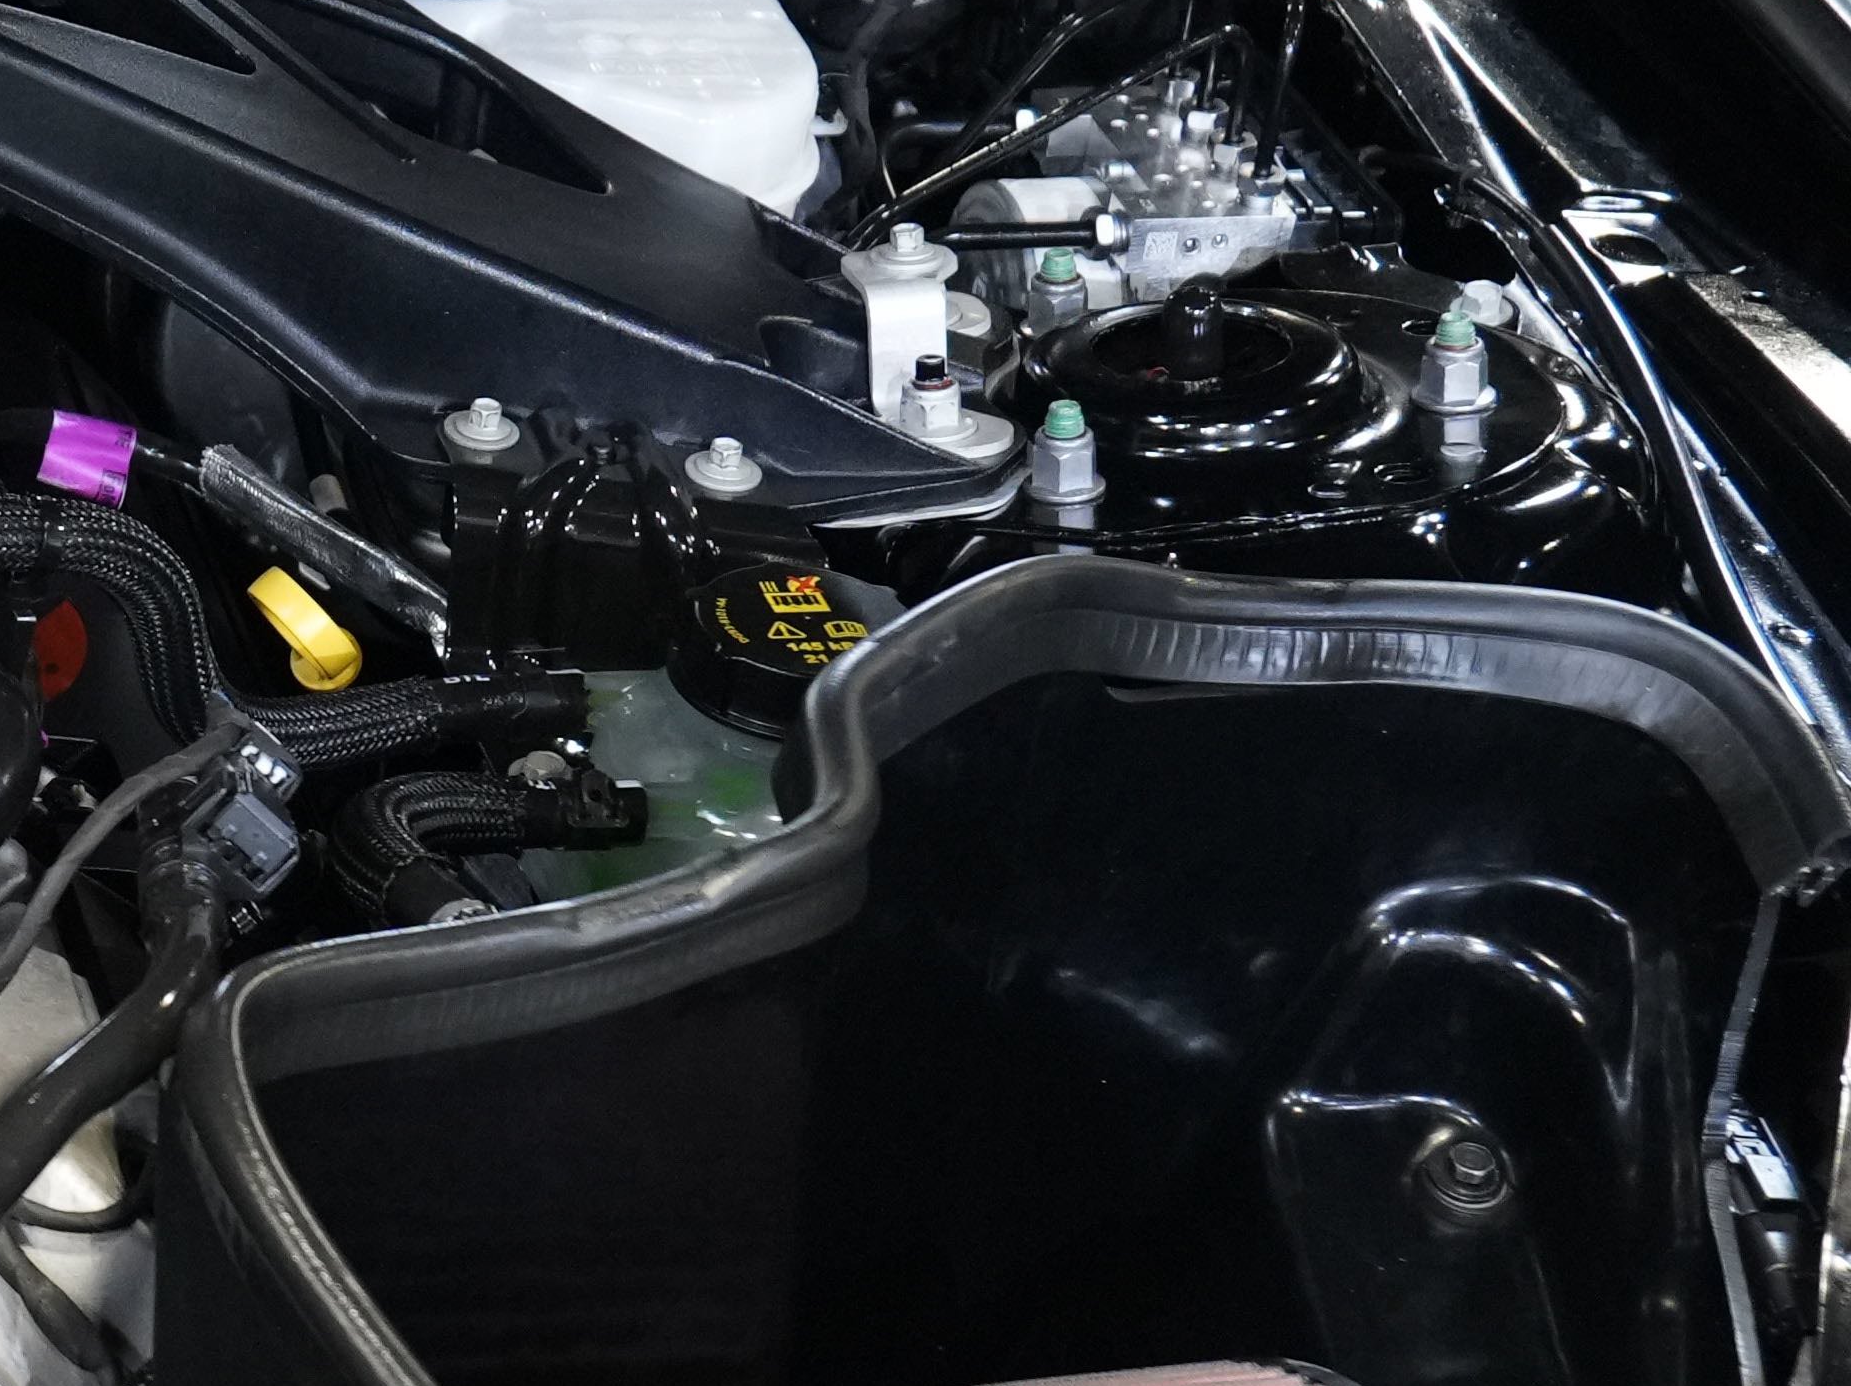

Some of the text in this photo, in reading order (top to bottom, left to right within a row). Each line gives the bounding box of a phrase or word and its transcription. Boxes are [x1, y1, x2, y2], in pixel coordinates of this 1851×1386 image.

[786, 640, 856, 652] 145 kP
[803, 653, 829, 664] 21
